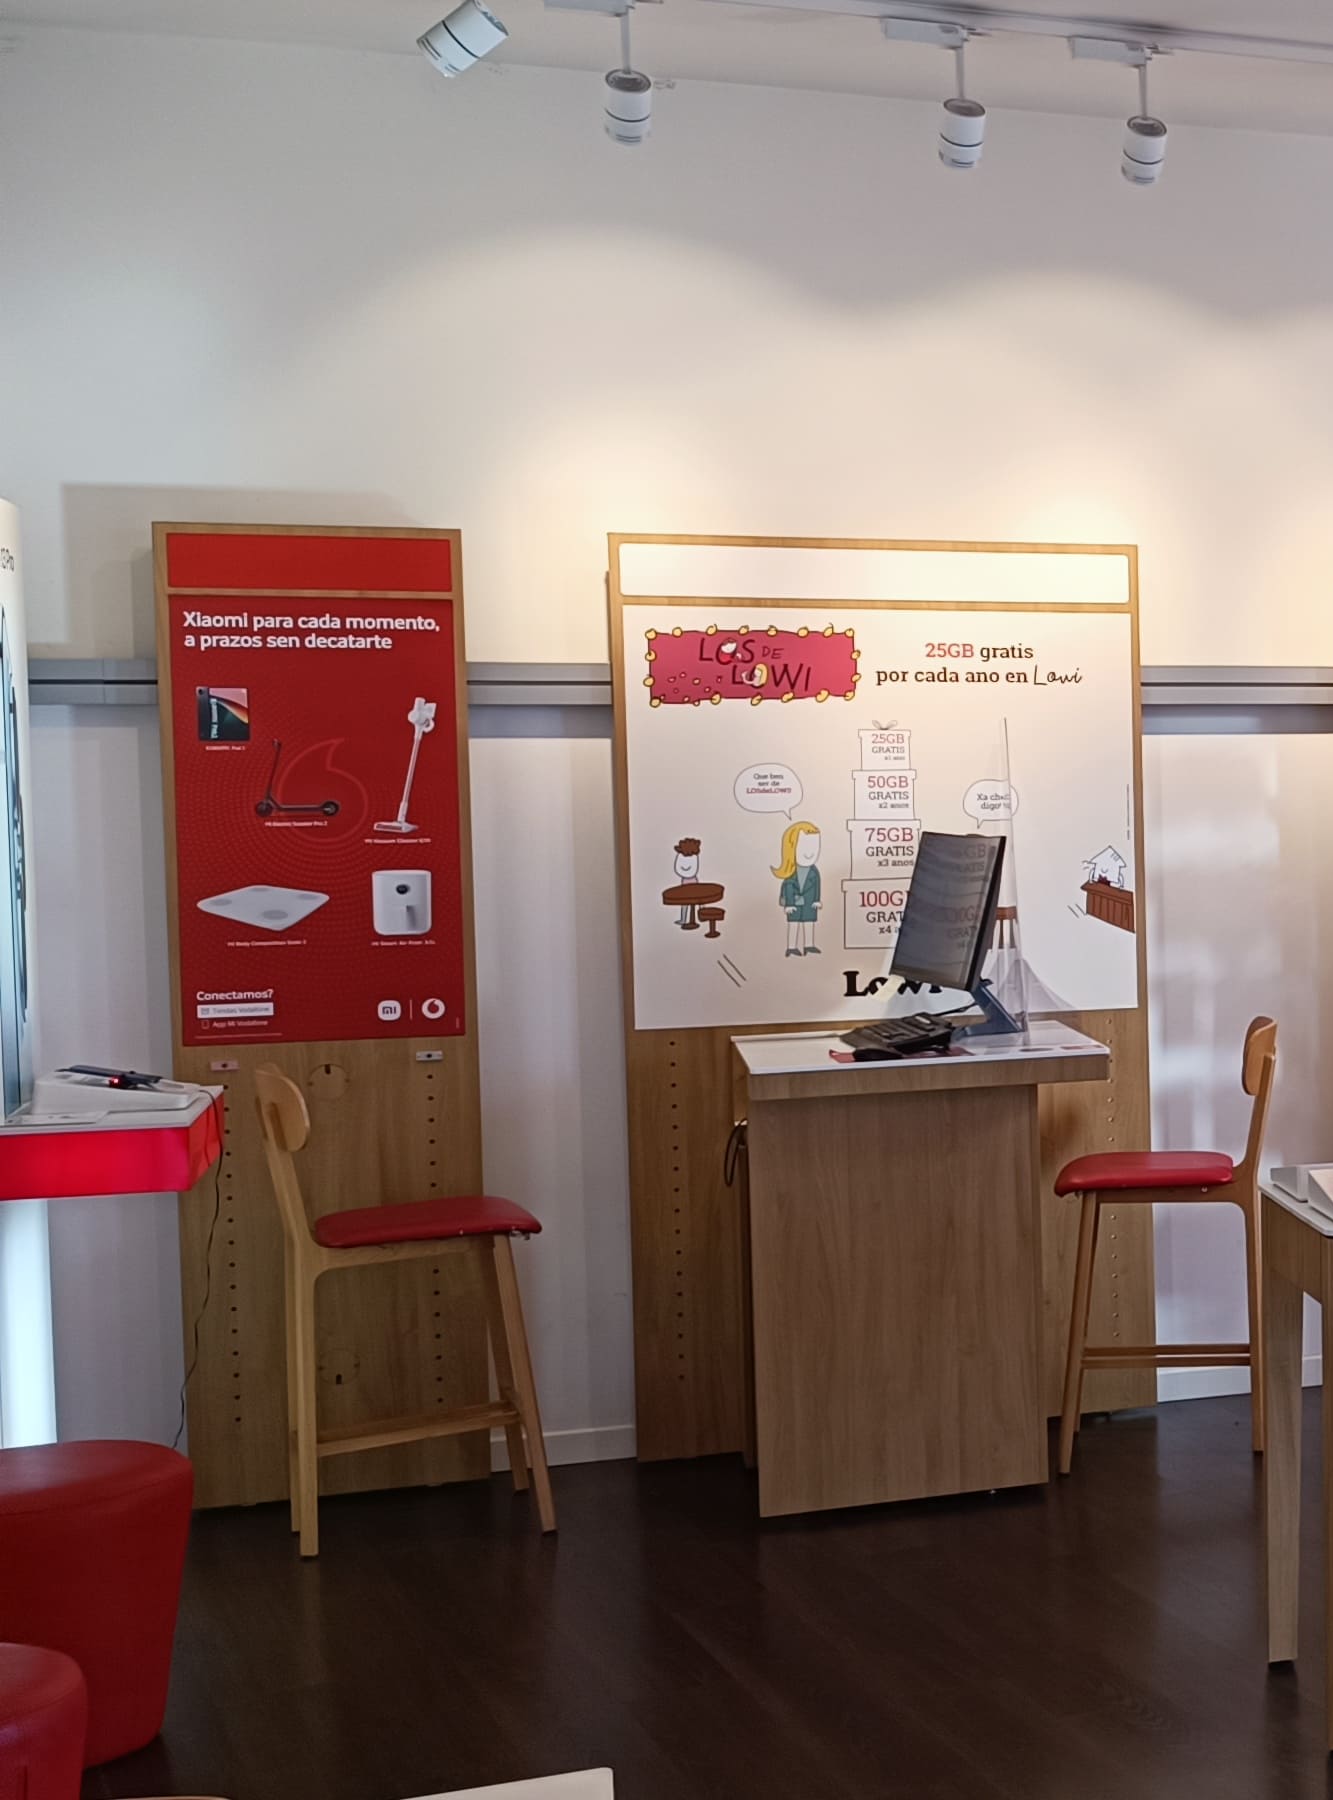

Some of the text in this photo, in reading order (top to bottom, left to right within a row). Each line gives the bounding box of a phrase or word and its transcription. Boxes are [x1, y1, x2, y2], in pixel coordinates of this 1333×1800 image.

[183, 612, 440, 632] Xiaomi para cada momento,
[184, 634, 393, 651] a prazos sen decatarte
[925, 643, 1034, 662] 25GB gratis
[876, 665, 1083, 686] por cada ano en Lowi
[871, 733, 905, 744] 25GB
[871, 746, 905, 754] GRATIS
[867, 776, 909, 789] 50GB
[868, 791, 909, 801] GRATIS
[865, 827, 914, 843] 75GB
[865, 846, 914, 857] GRATIS
[891, 858, 914, 867] anos
[196, 989, 274, 1001] Conectamos?
